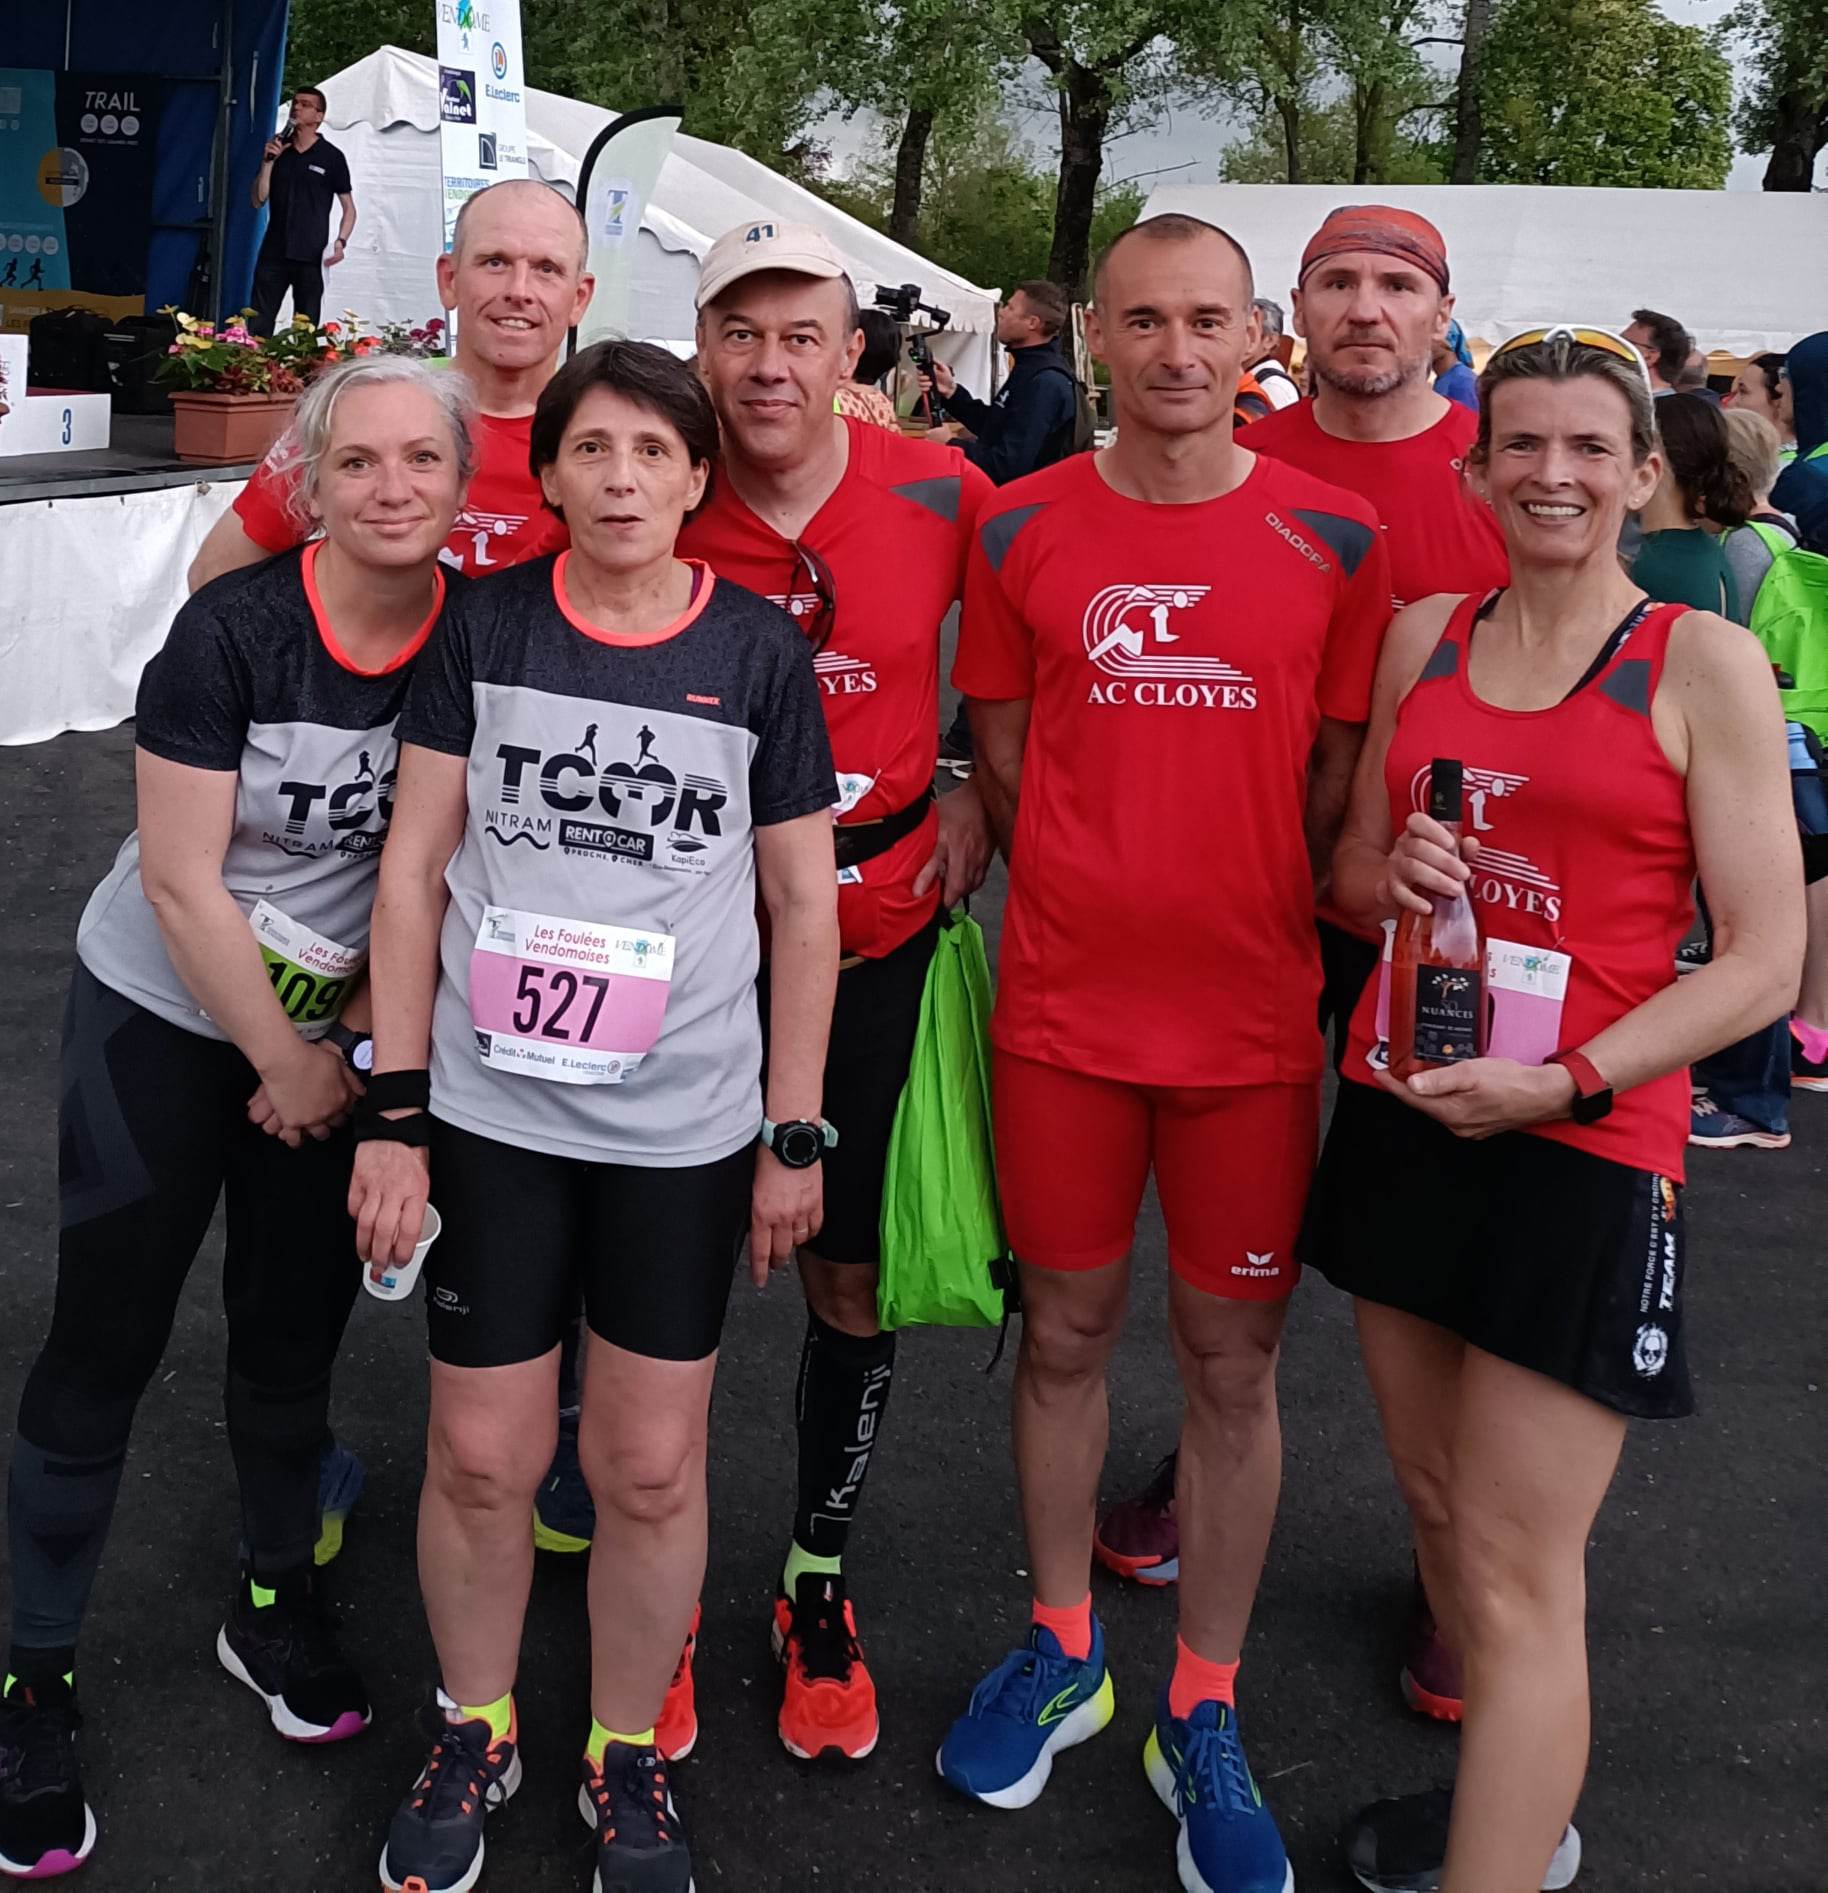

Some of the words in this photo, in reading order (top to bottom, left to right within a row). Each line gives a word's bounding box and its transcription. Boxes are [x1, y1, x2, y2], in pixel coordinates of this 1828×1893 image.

[85, 91, 140, 111] TRAIL
[746, 224, 774, 243] 41
[62, 408, 72, 445] 3
[1264, 511, 1332, 574] DIADORA
[1087, 682, 1127, 704] AC
[1133, 682, 1257, 710] CLOYES
[485, 809, 551, 832] NITRAM
[262, 831, 335, 852] NITRAM
[671, 853, 706, 867] KapiEco
[534, 924, 555, 940] Les
[556, 928, 606, 948] Foulées
[310, 942, 328, 958] Les
[525, 938, 610, 965] Vendomoises
[512, 965, 610, 1043] 527
[1421, 1005, 1474, 1019] NUANCES
[493, 1044, 517, 1058] Crédit
[526, 1051, 556, 1065] Mutuel
[561, 1057, 607, 1072] E.Leclerc
[1231, 1265, 1279, 1277] erima
[1659, 1231, 1677, 1312] TEAM
[1640, 1282, 1653, 1313] NOTRE
